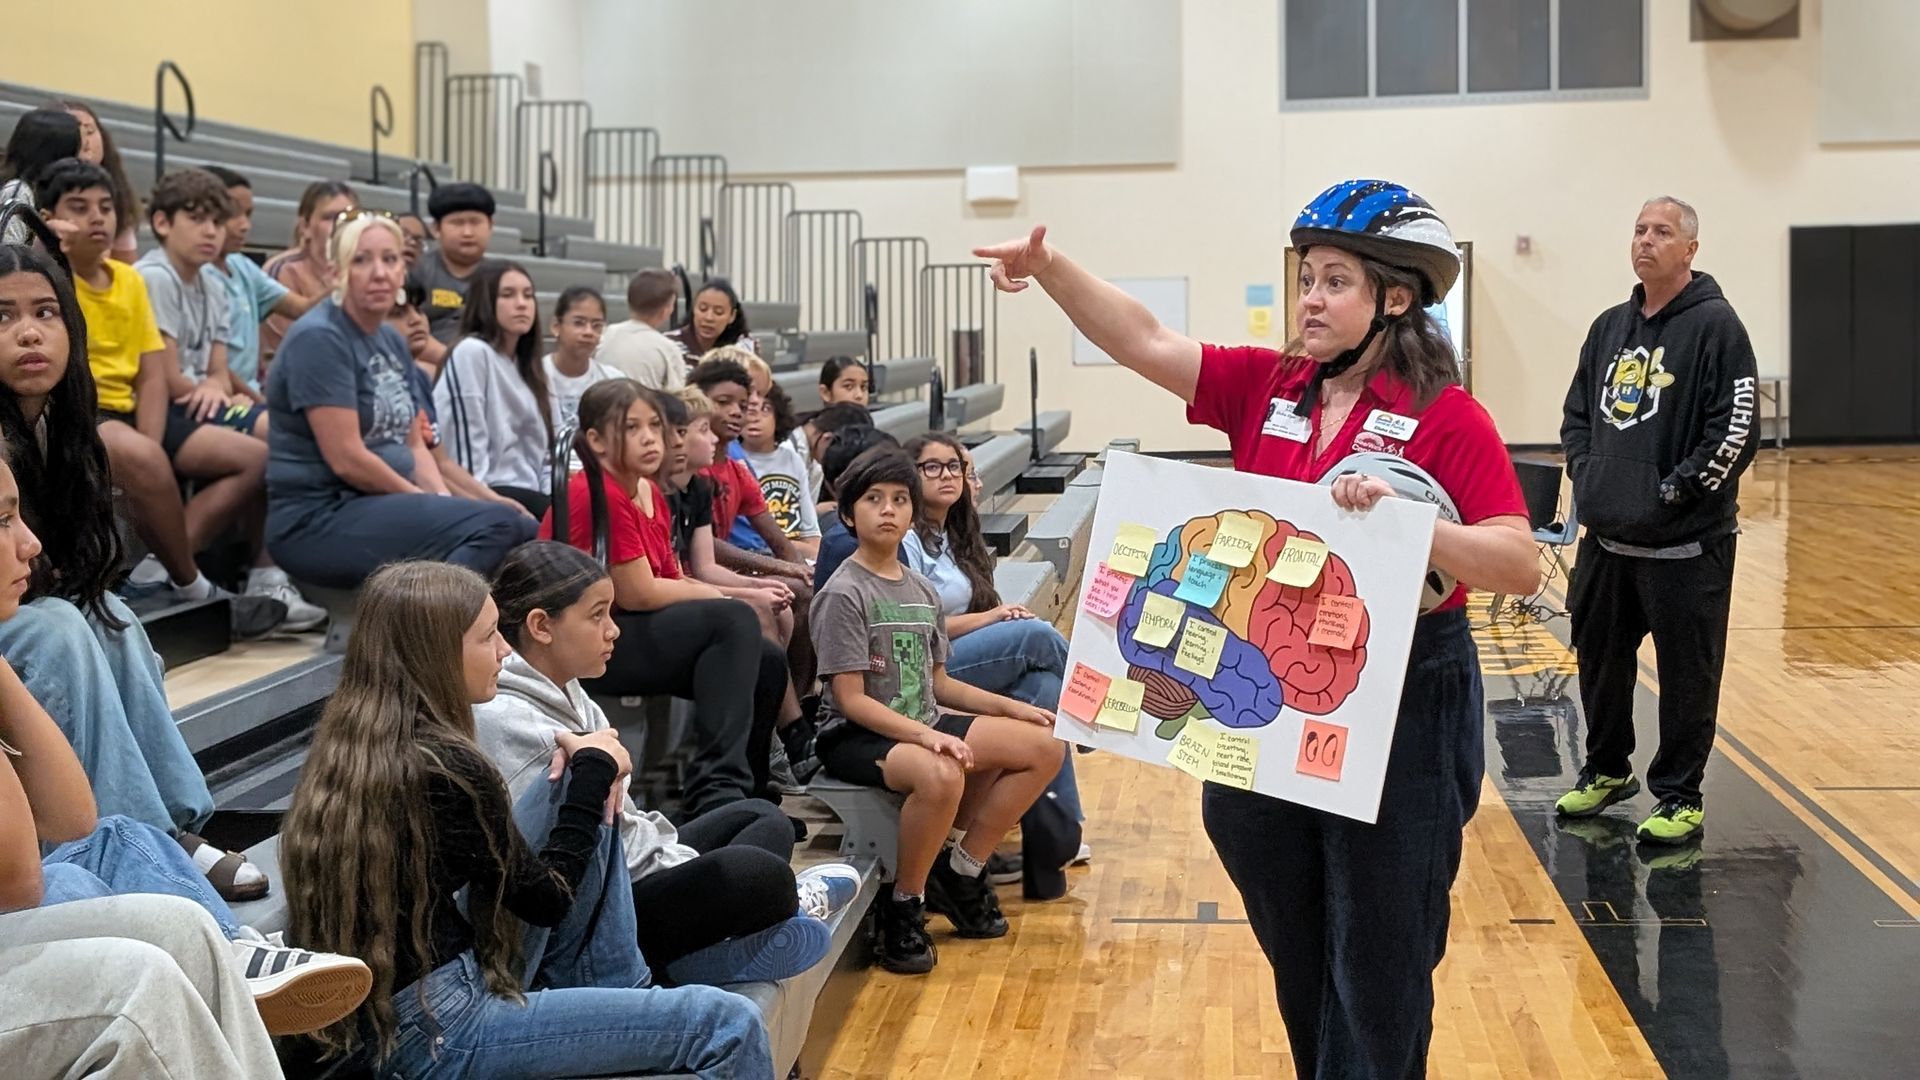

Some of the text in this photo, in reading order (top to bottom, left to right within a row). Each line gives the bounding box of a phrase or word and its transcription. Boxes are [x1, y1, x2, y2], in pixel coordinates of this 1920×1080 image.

[1622, 386, 1632, 395] H
[1700, 376, 1755, 491] HORNETS
[1214, 532, 1254, 553] PARIETAL
[1113, 543, 1149, 561] OCCIPITAL
[1280, 547, 1321, 567] FRONTAL
[1188, 576, 1207, 588] touch
[1321, 597, 1354, 609] I control
[1141, 611, 1176, 631] TEMPORAL
[1189, 620, 1217, 637] I control
[1103, 696, 1139, 712] CEREBELLUM
[1180, 734, 1210, 758] BRAIN
[1220, 732, 1250, 744] I control
[1177, 749, 1199, 768] STEM
